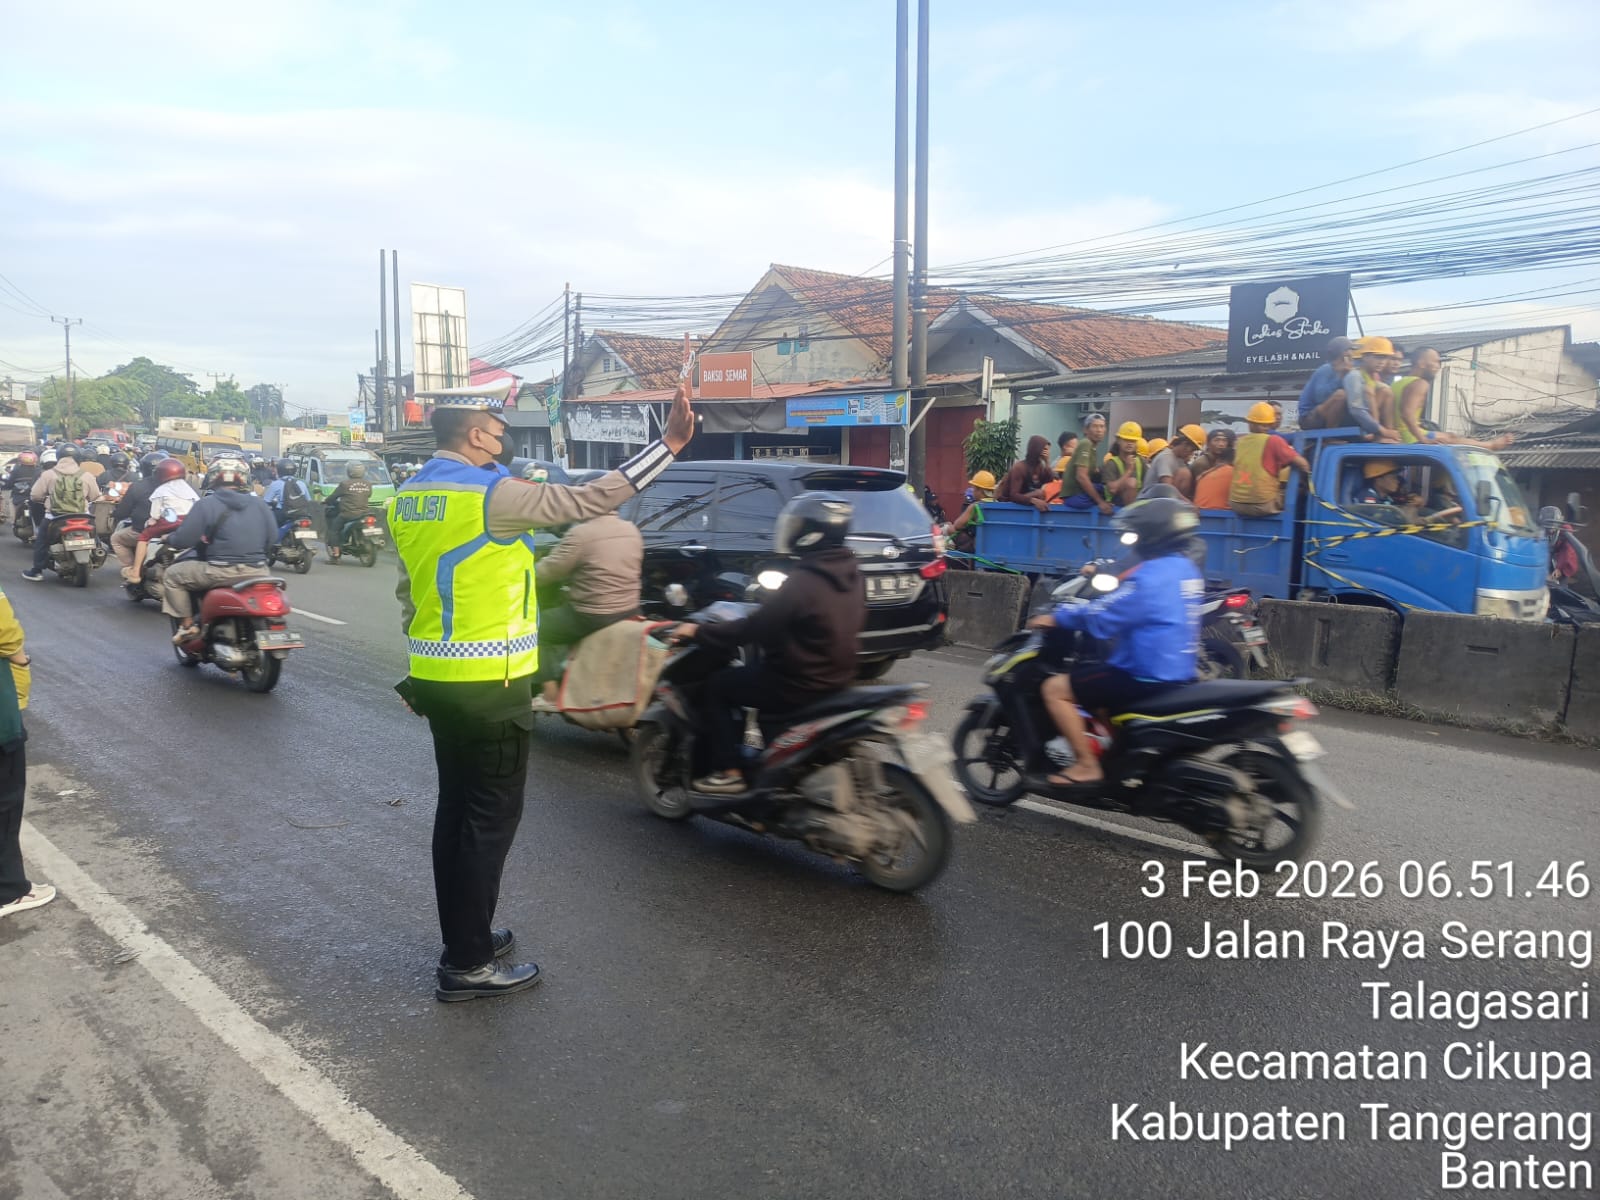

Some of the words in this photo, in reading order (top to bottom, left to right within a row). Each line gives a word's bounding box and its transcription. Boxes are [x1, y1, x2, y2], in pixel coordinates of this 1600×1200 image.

[1245, 324, 1282, 346] Ladies
[1284, 317, 1330, 339] Studio
[1246, 353, 1289, 363] EYELASH
[1298, 352, 1320, 360] NAIL
[703, 370, 723, 382] BAKSO
[726, 369, 747, 381] SEMAR
[393, 495, 447, 521] POLISI
